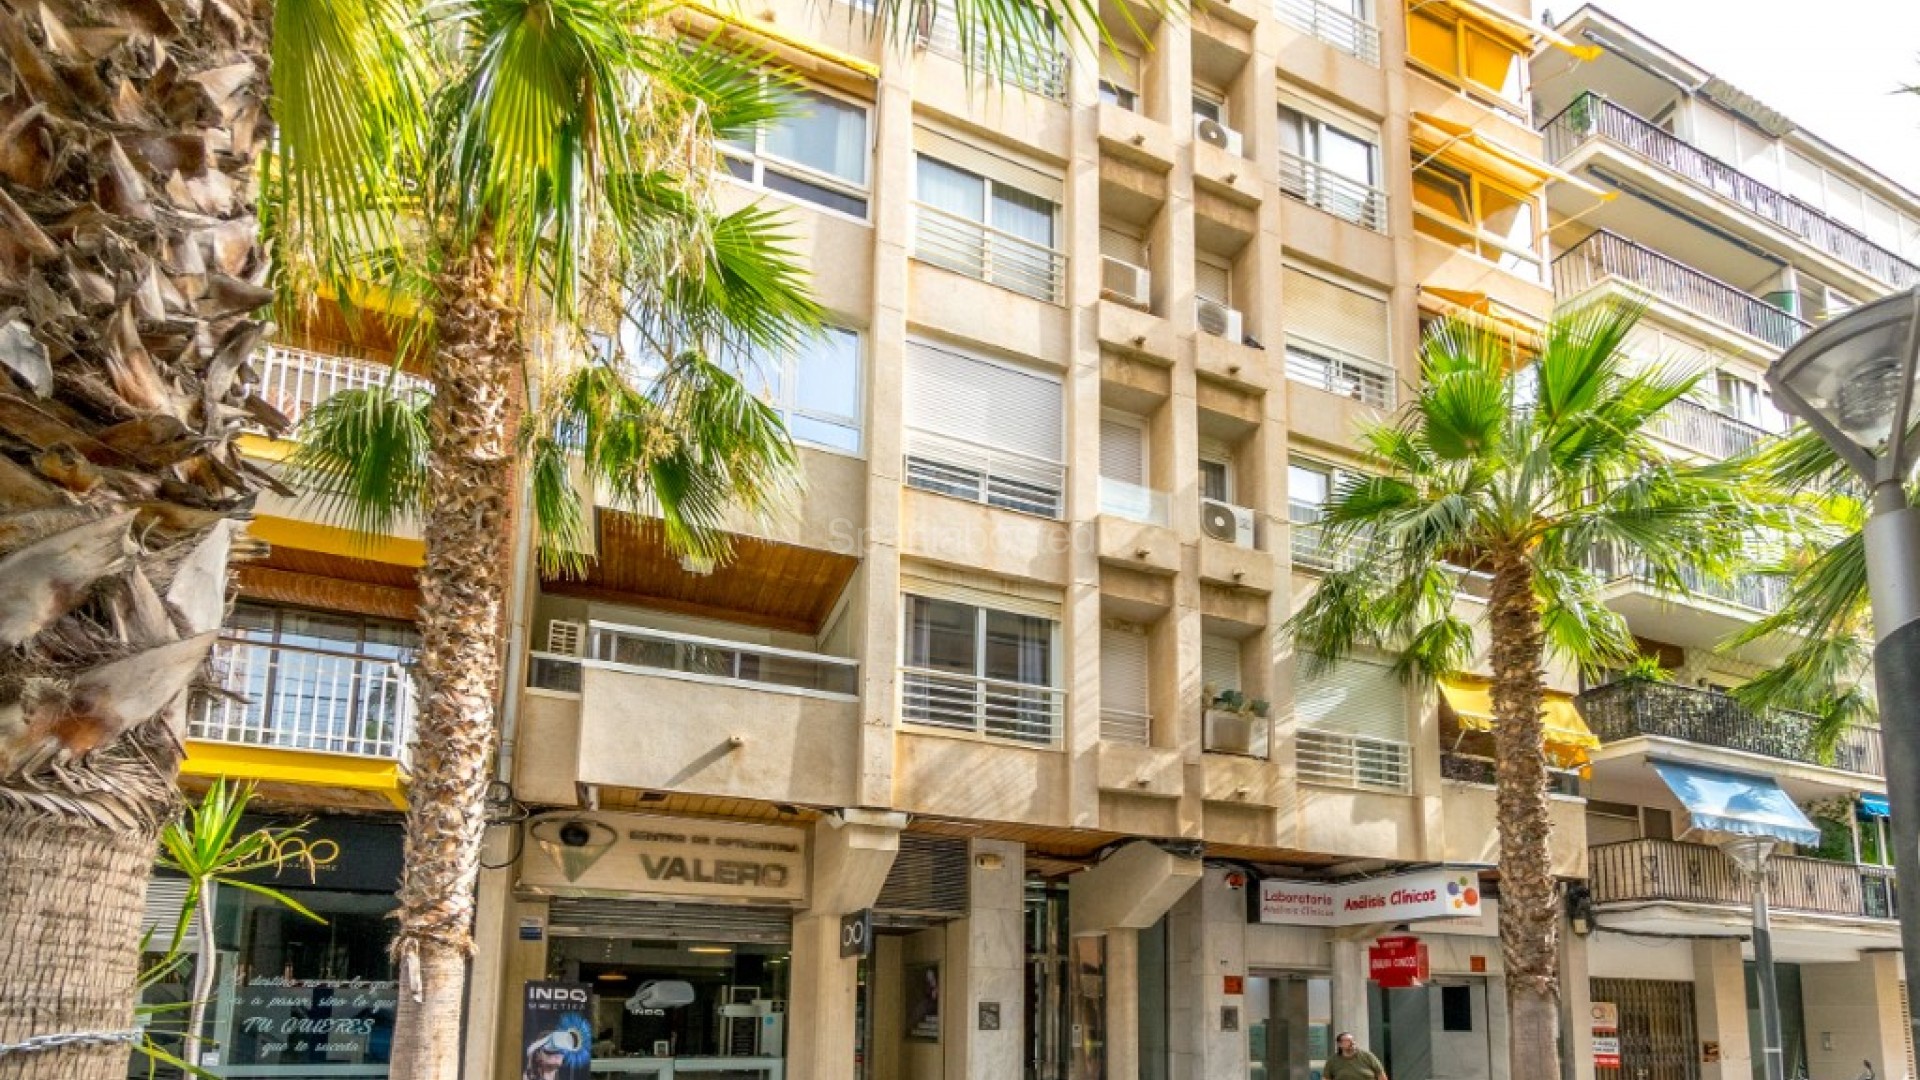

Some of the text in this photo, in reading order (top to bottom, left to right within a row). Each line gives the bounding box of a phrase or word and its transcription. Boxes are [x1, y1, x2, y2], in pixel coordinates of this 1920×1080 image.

[639, 853, 788, 888] VALERO
[1263, 889, 1333, 906] Laboratorio
[1343, 888, 1437, 911] Análisis Clínicos
[528, 986, 588, 1003] INDO
